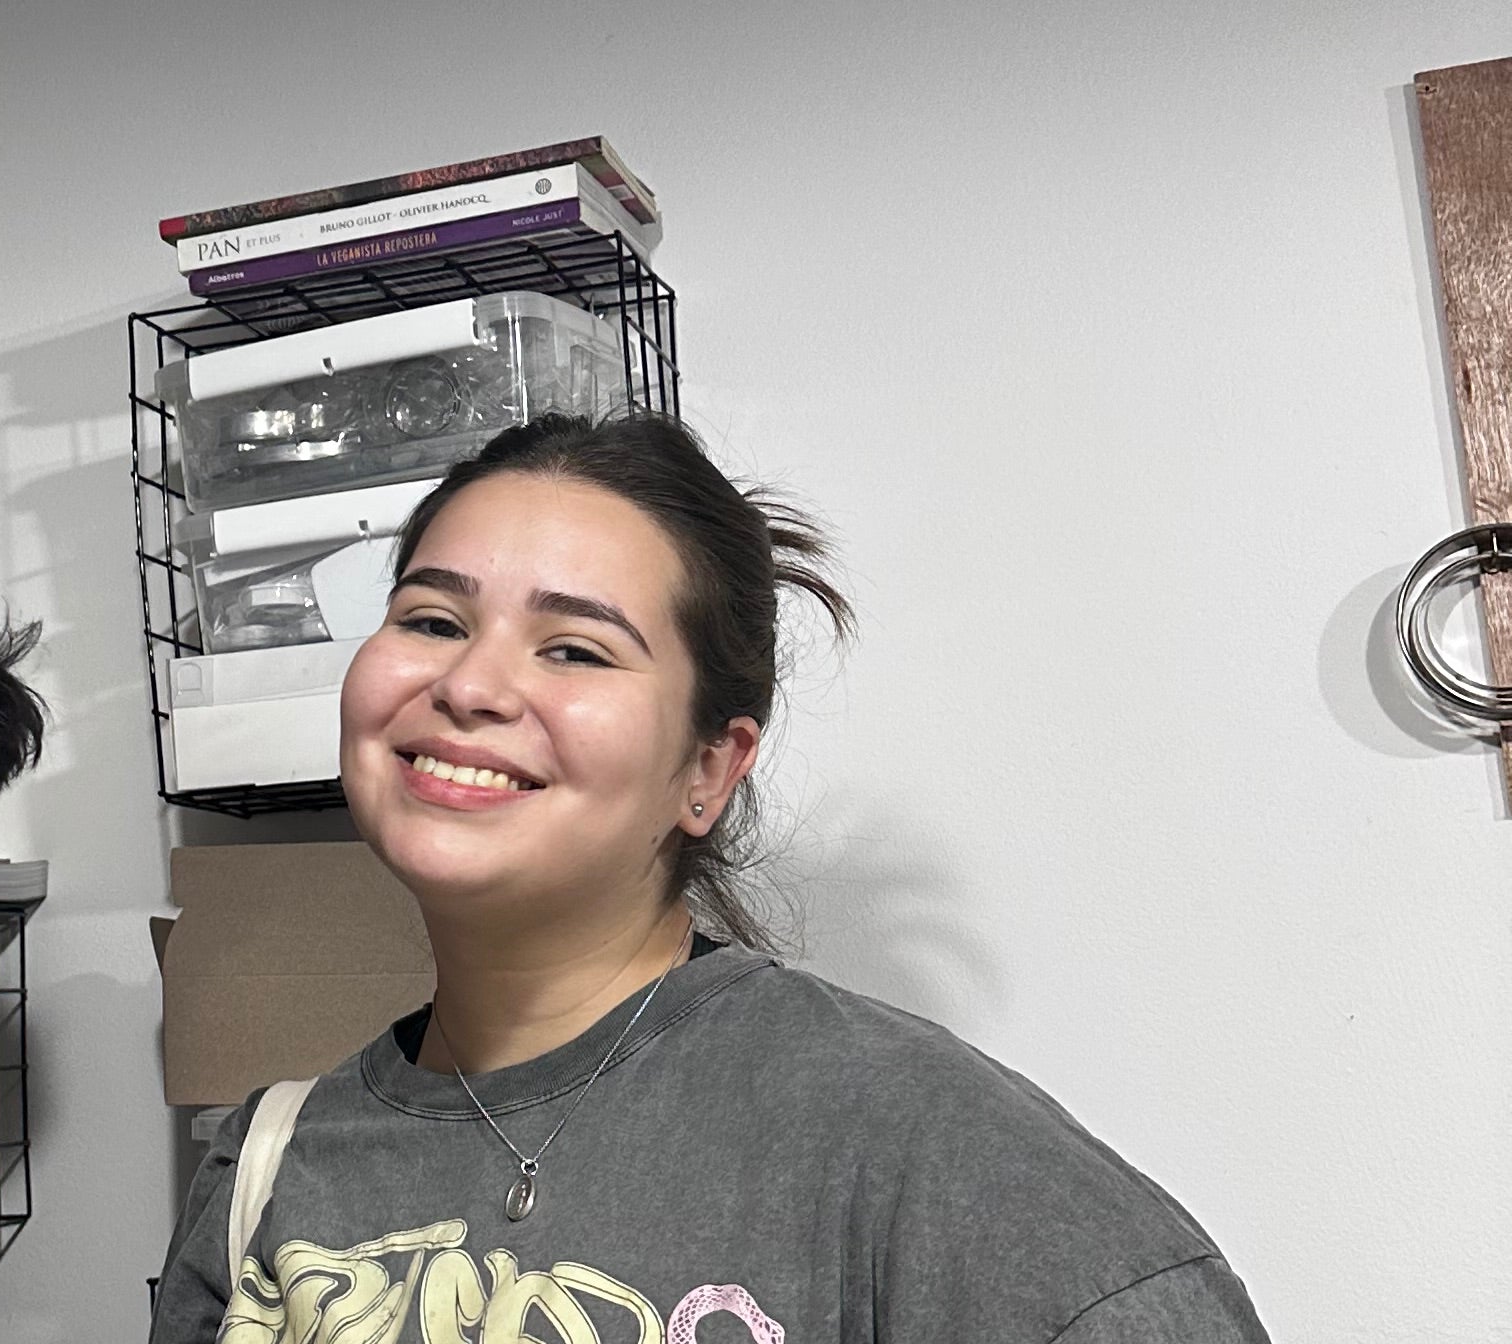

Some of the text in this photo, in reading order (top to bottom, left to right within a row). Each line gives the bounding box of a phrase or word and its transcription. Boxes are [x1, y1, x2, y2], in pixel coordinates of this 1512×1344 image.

[319, 193, 492, 234] BRUNO GILLOT OLIVIER HANOCQ
[512, 208, 564, 227] NICOLE JUST
[197, 233, 281, 262] PAN ET PLUS
[316, 231, 438, 267] LA VEGANISTA REPOSTERA
[208, 271, 245, 284] Albatros
